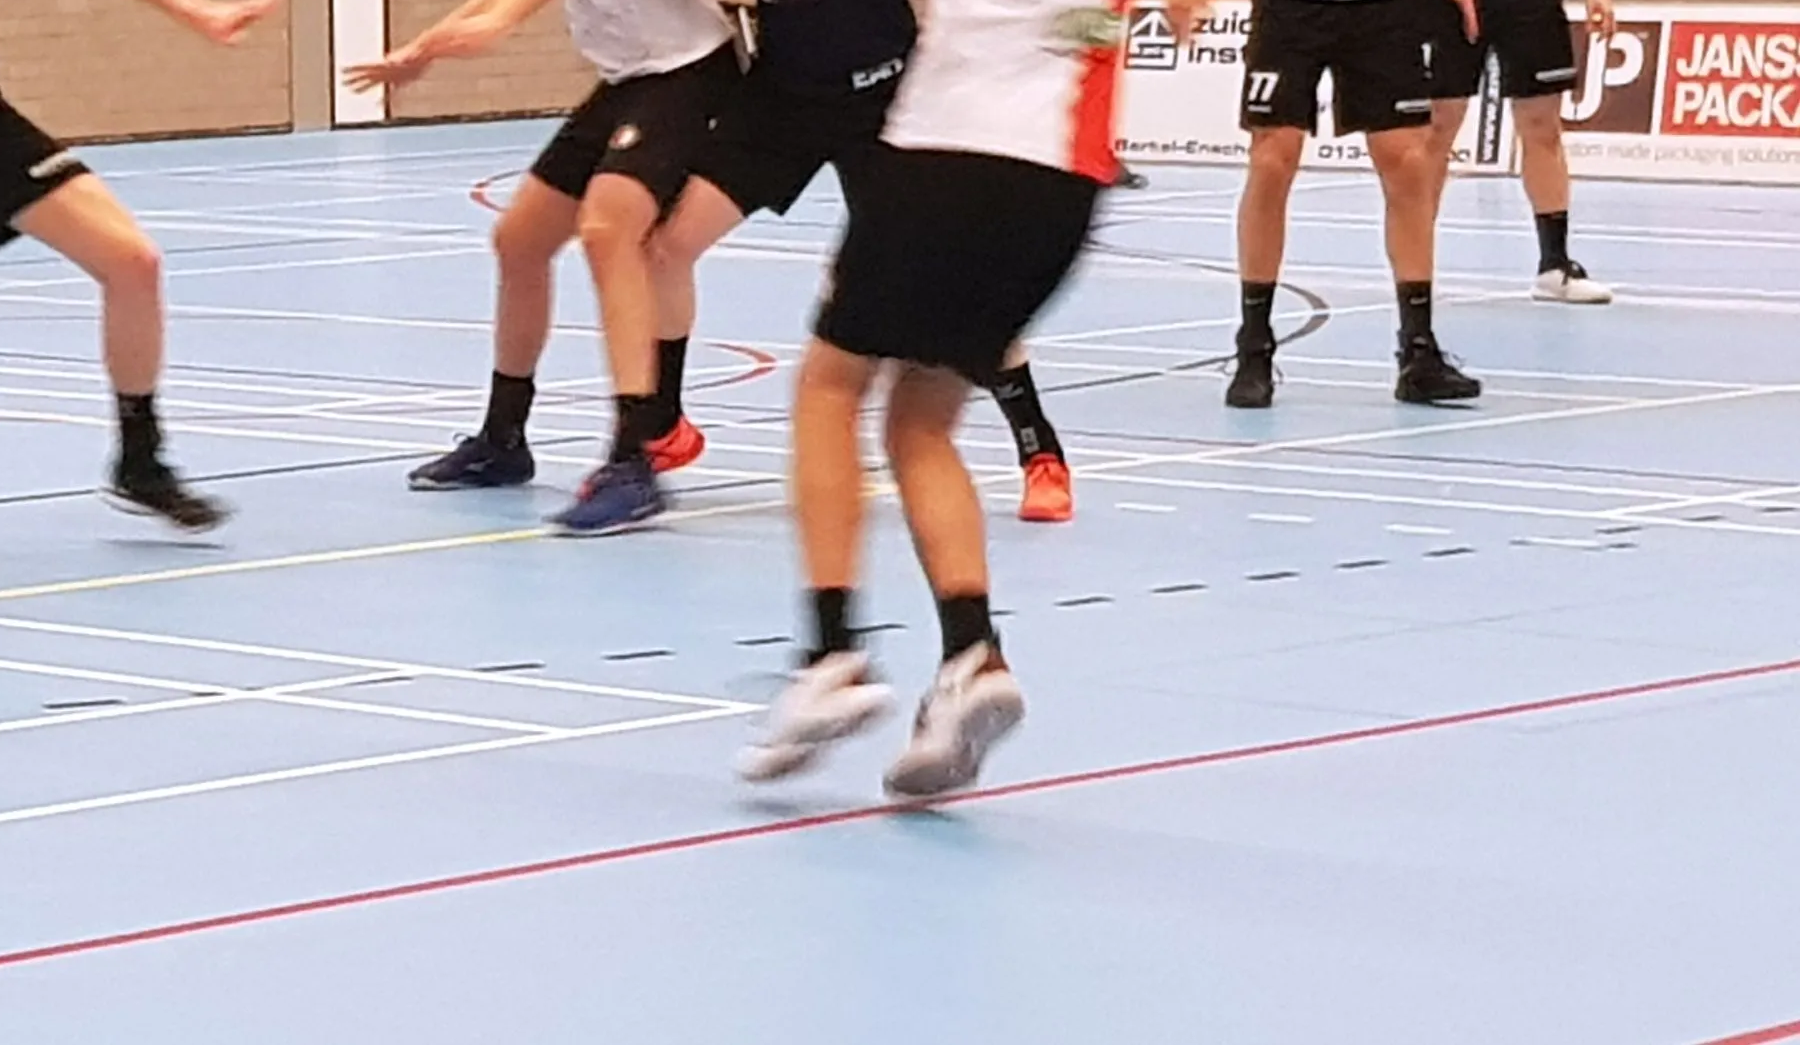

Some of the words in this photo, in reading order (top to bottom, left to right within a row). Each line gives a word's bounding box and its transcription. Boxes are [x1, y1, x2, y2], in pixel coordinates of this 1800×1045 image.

[1188, 39, 1246, 64] ins
[1675, 32, 1800, 80] JANS
[1248, 70, 1279, 102] 77
[1672, 81, 1800, 129] PACK
